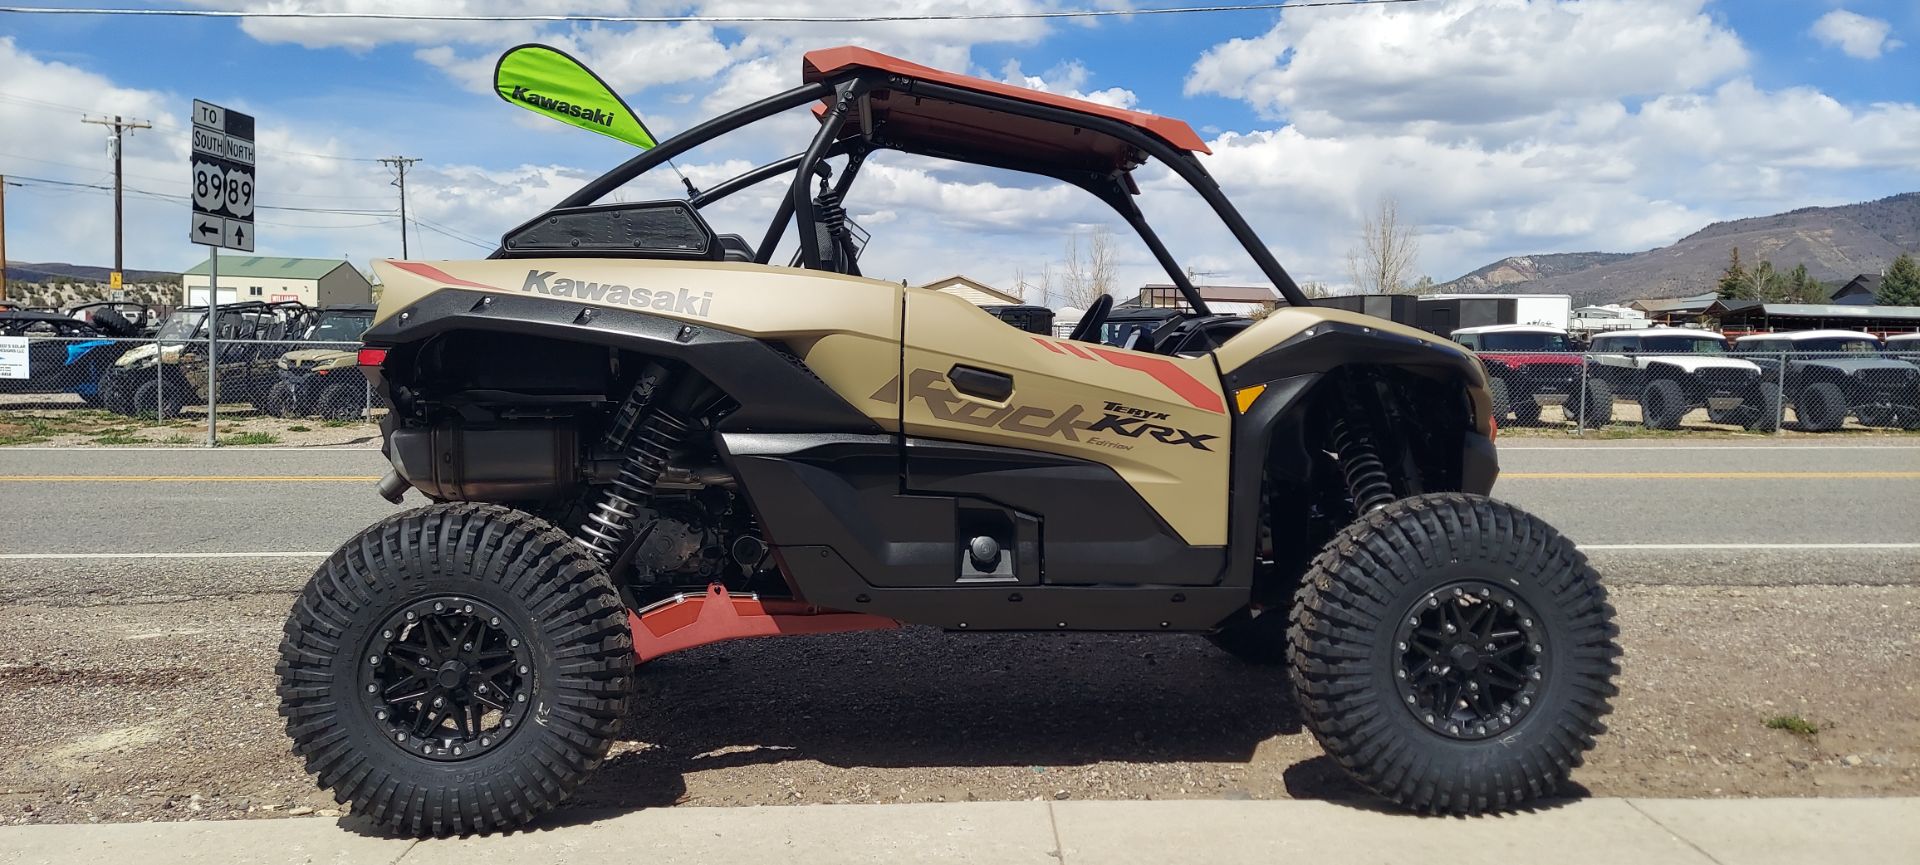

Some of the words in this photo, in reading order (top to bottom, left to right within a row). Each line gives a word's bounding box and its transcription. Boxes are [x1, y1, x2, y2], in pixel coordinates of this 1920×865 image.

[201, 107, 217, 124] TO
[511, 85, 615, 128] Kawasaki
[194, 130, 223, 154] SOUTH
[226, 140, 254, 162] NORTH
[197, 170, 222, 200] 89
[227, 179, 252, 207] 89
[522, 269, 713, 318] Kawasaki
[1086, 413, 1220, 452] KRX
